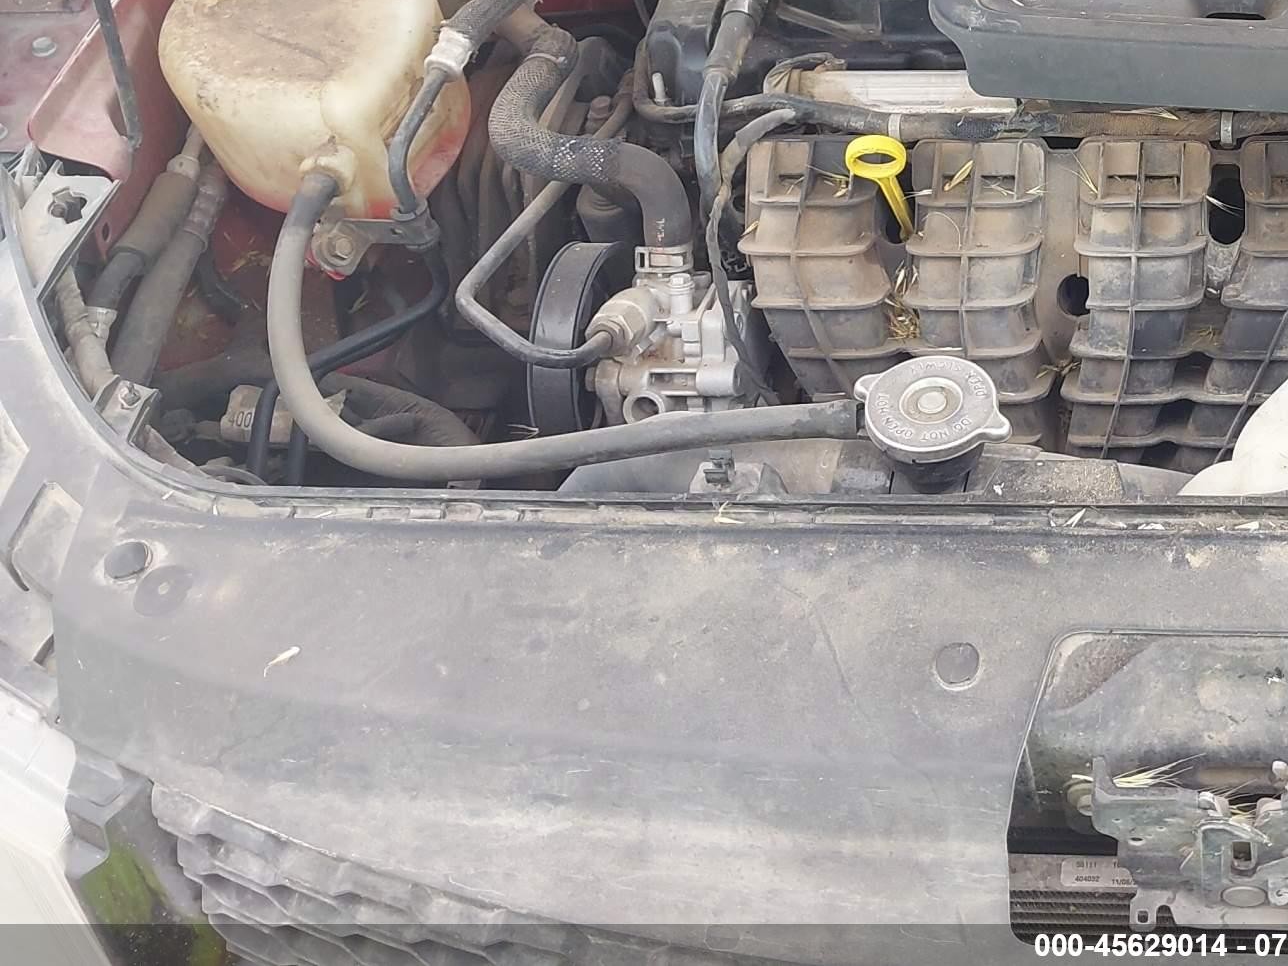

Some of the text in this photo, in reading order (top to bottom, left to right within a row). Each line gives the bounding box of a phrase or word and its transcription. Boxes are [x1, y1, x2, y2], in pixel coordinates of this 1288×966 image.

[875, 392, 973, 443] DO NOT OPEN HOT
